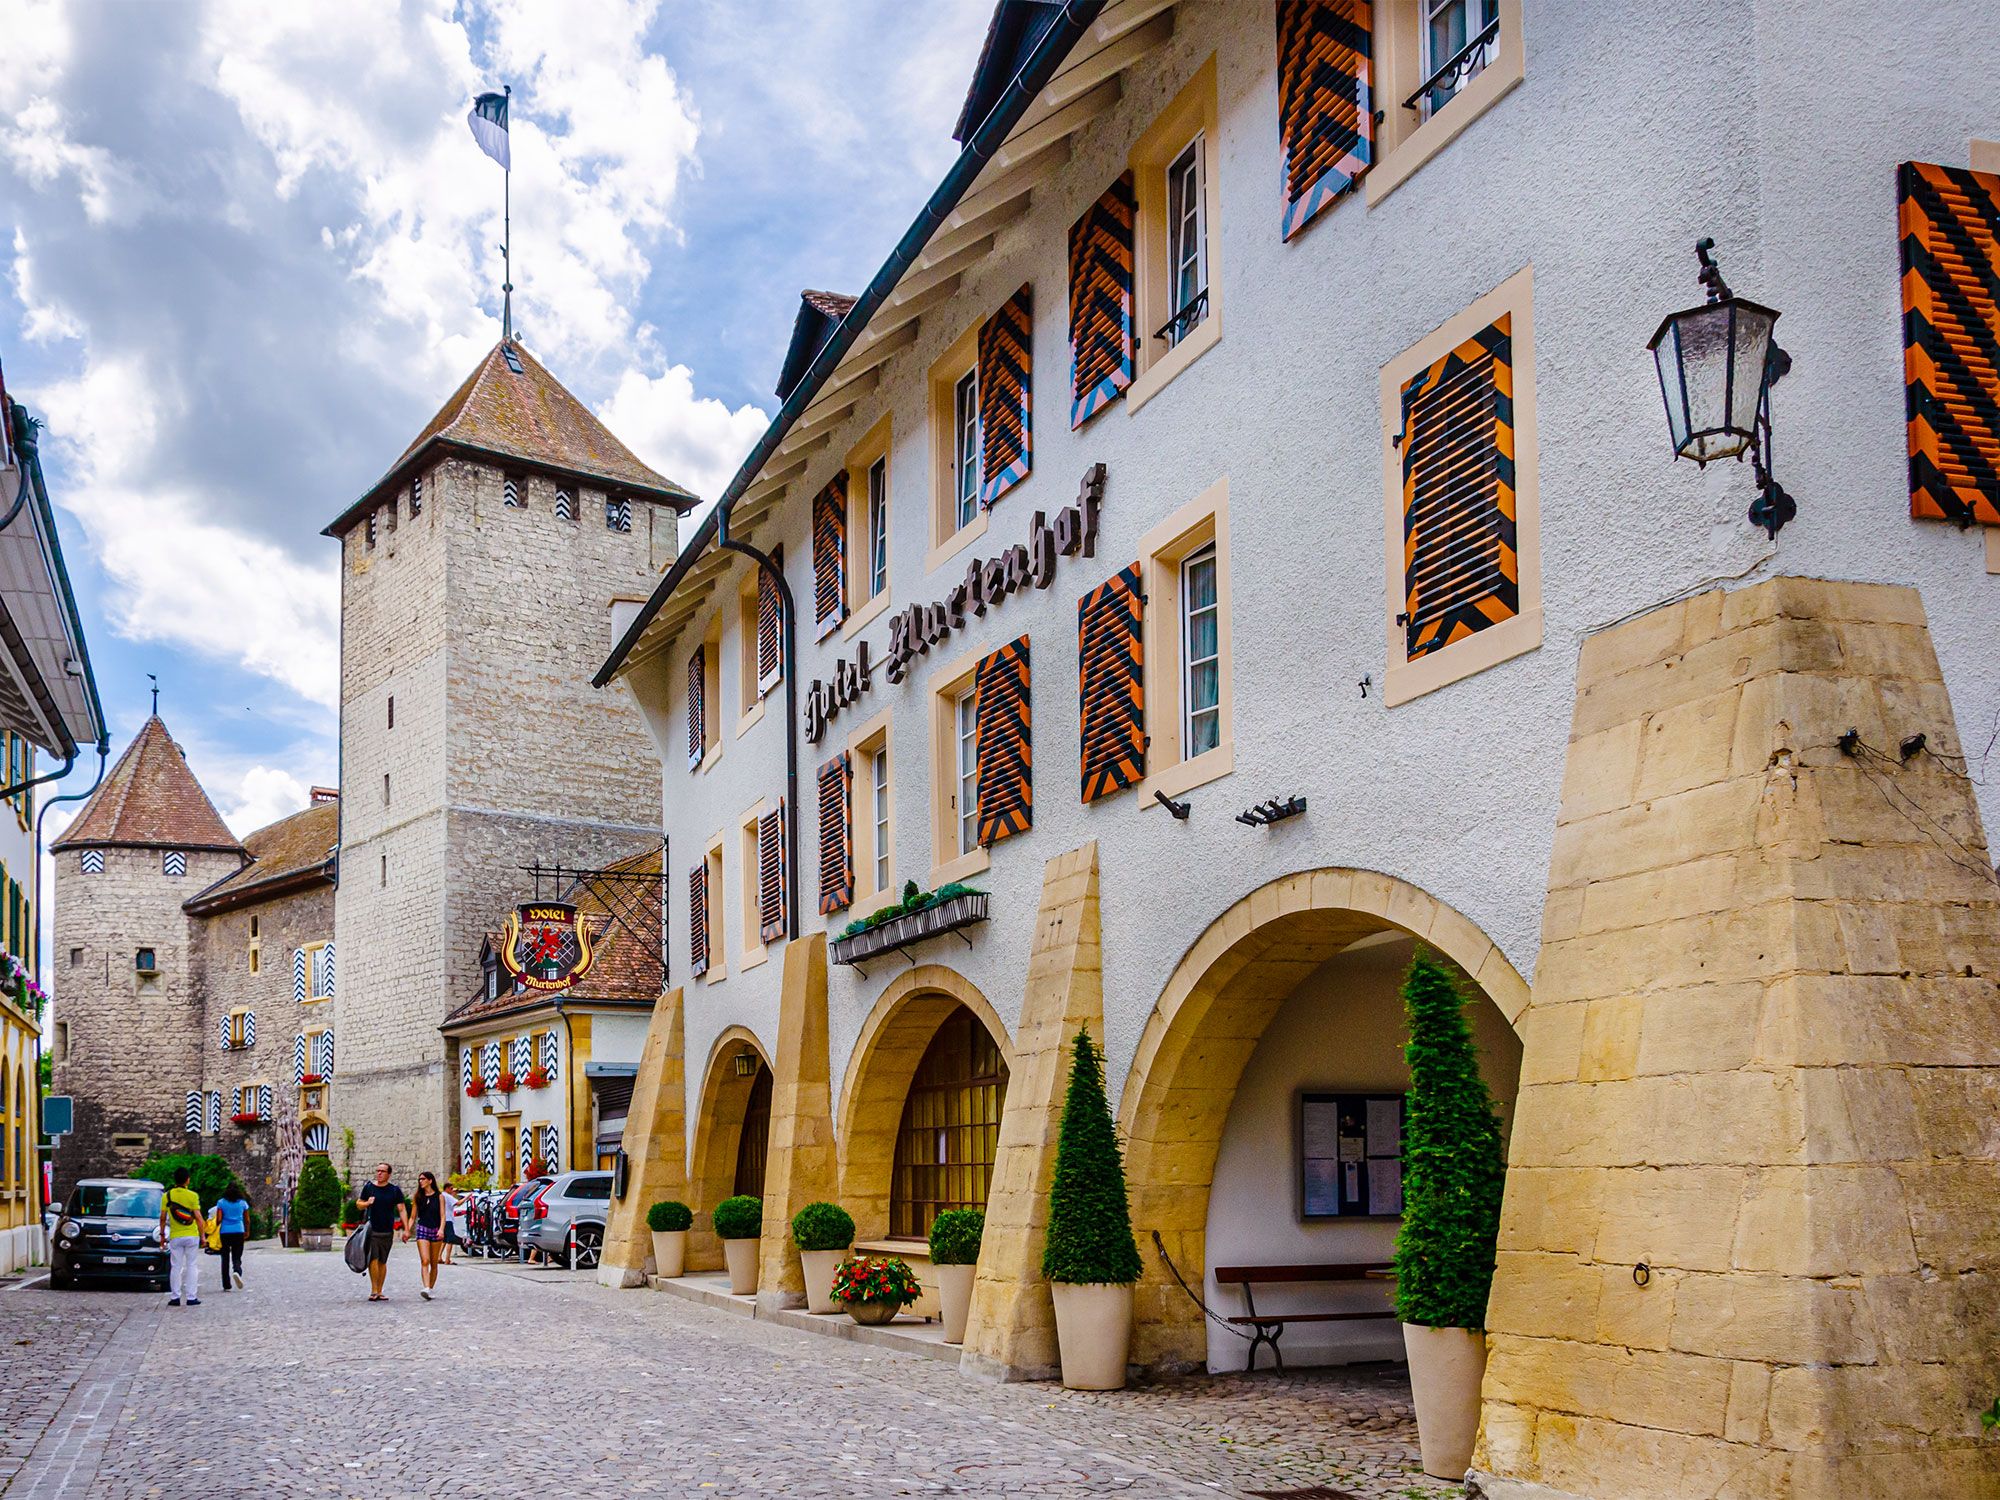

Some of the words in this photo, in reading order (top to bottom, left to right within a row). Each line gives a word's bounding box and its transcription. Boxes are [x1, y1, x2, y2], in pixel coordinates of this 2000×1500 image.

[804, 641, 871, 744] Hotel
[886, 462, 1107, 685] Murtenhof
[530, 909, 565, 920] Hotel
[525, 975, 571, 989] Murtenhof
